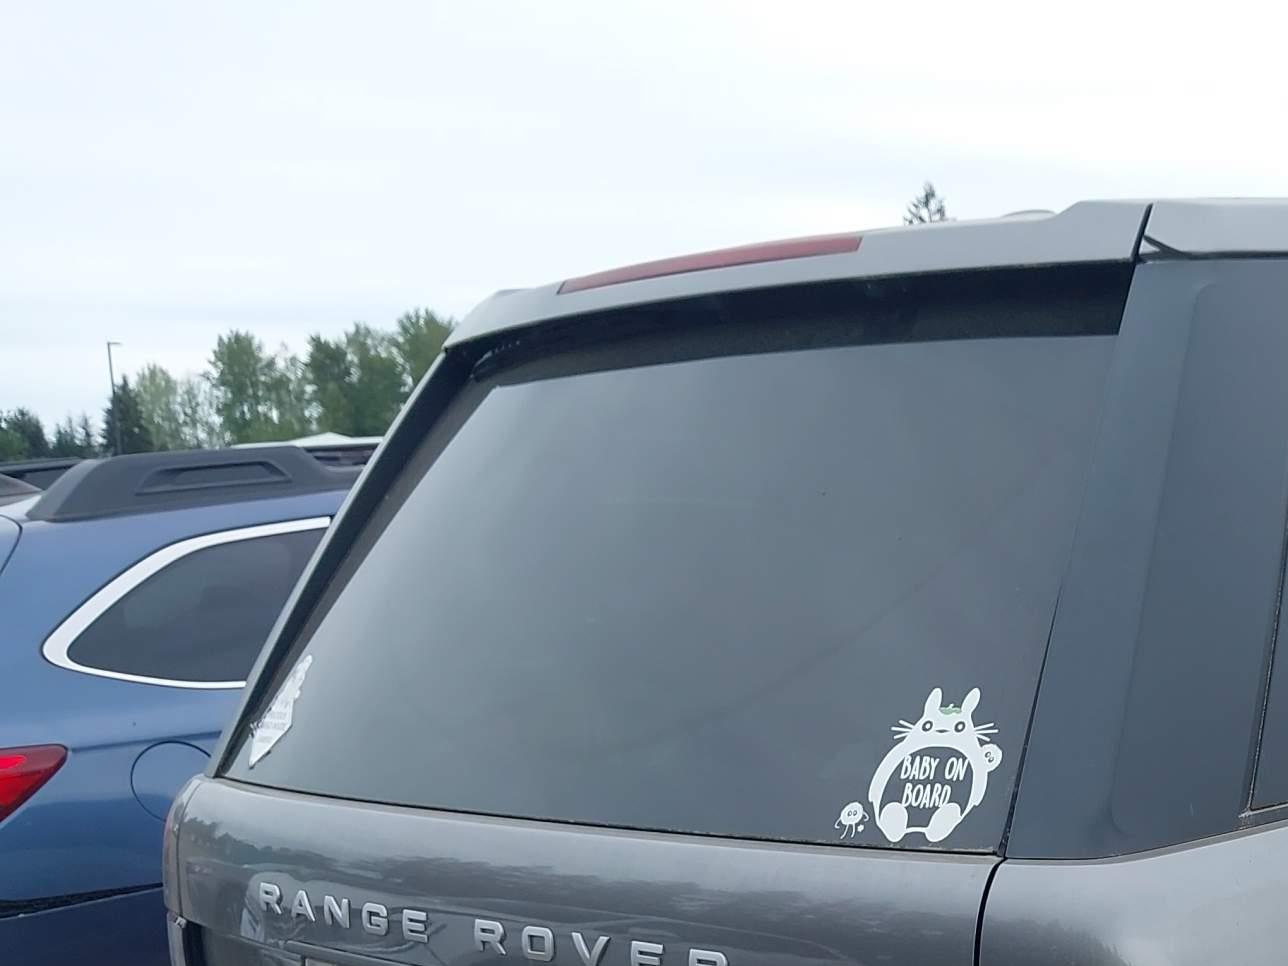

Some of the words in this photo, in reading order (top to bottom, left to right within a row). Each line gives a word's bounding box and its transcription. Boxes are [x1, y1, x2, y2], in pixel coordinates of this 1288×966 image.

[900, 755, 940, 780] BABY
[944, 756, 969, 782] ON
[901, 782, 951, 809] BOARD
[258, 880, 430, 944] RANGE
